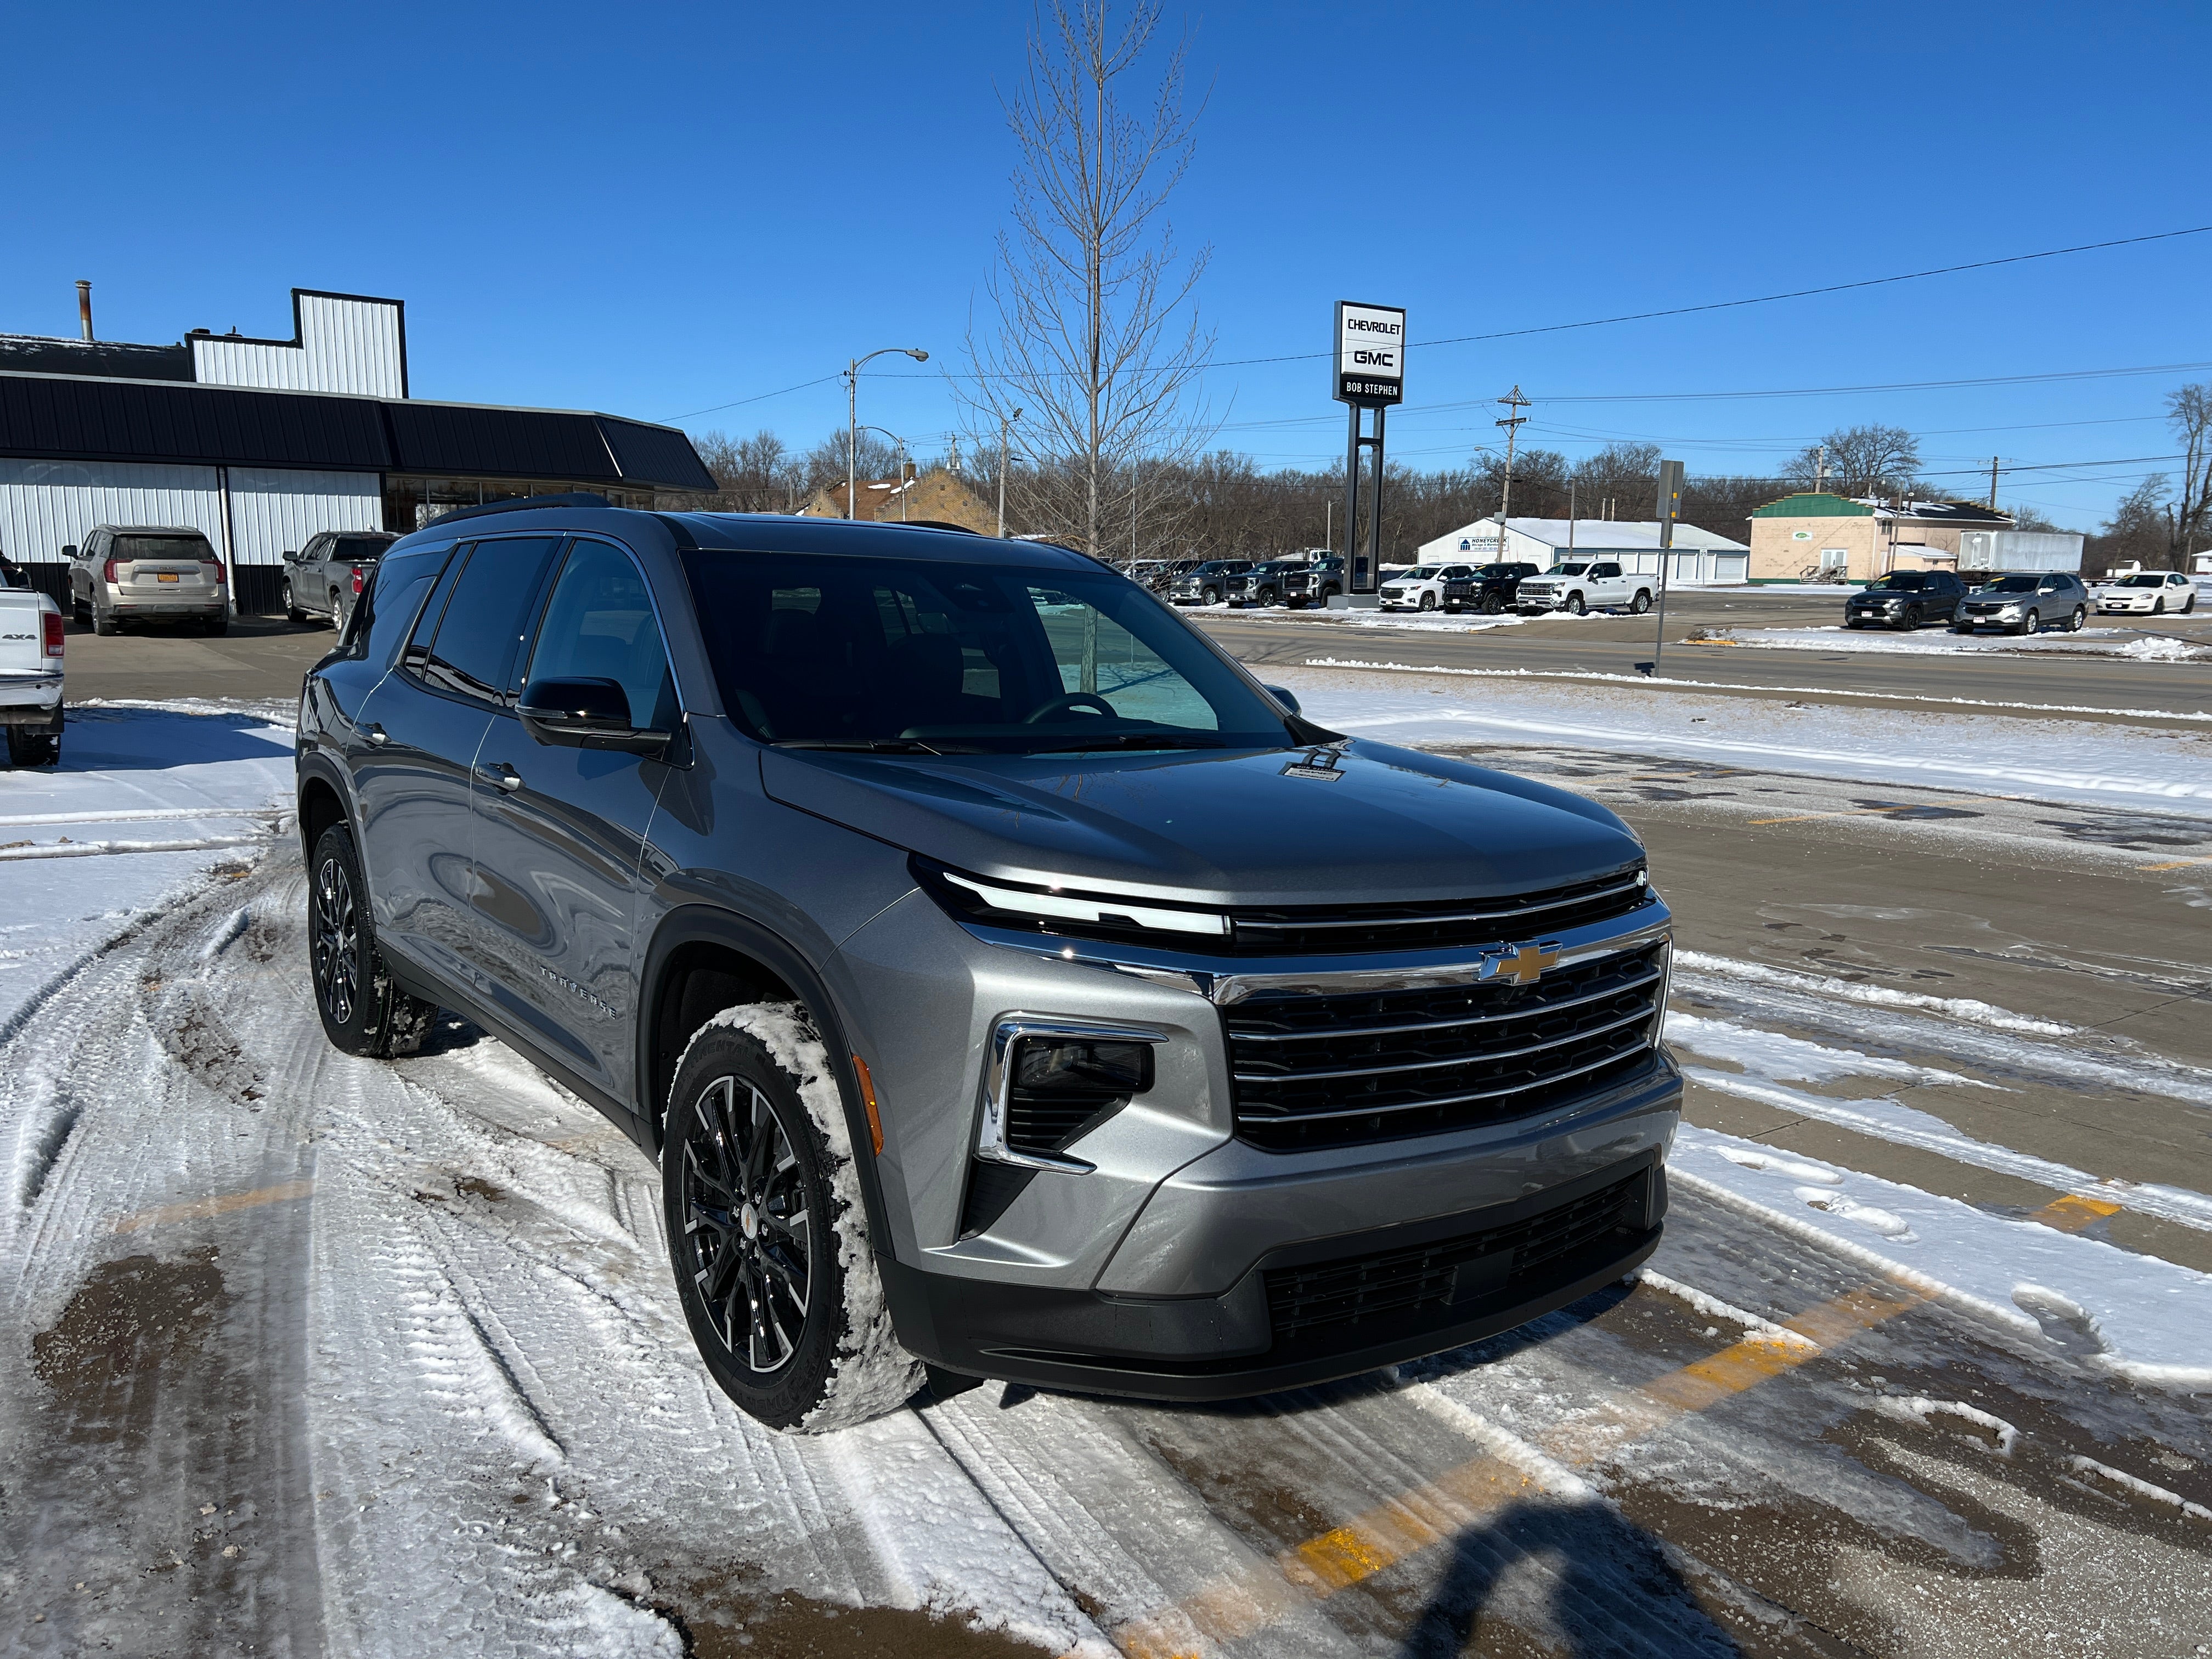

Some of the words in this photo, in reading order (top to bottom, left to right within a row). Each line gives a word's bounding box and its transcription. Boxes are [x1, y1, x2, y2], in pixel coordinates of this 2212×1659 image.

[1348, 319, 1401, 335] CHEVROLET
[1355, 351, 1393, 366] GMC
[1346, 382, 1362, 392] BOB
[1365, 383, 1398, 396] STEPHEN
[539, 965, 617, 1020] TRAVERSE
